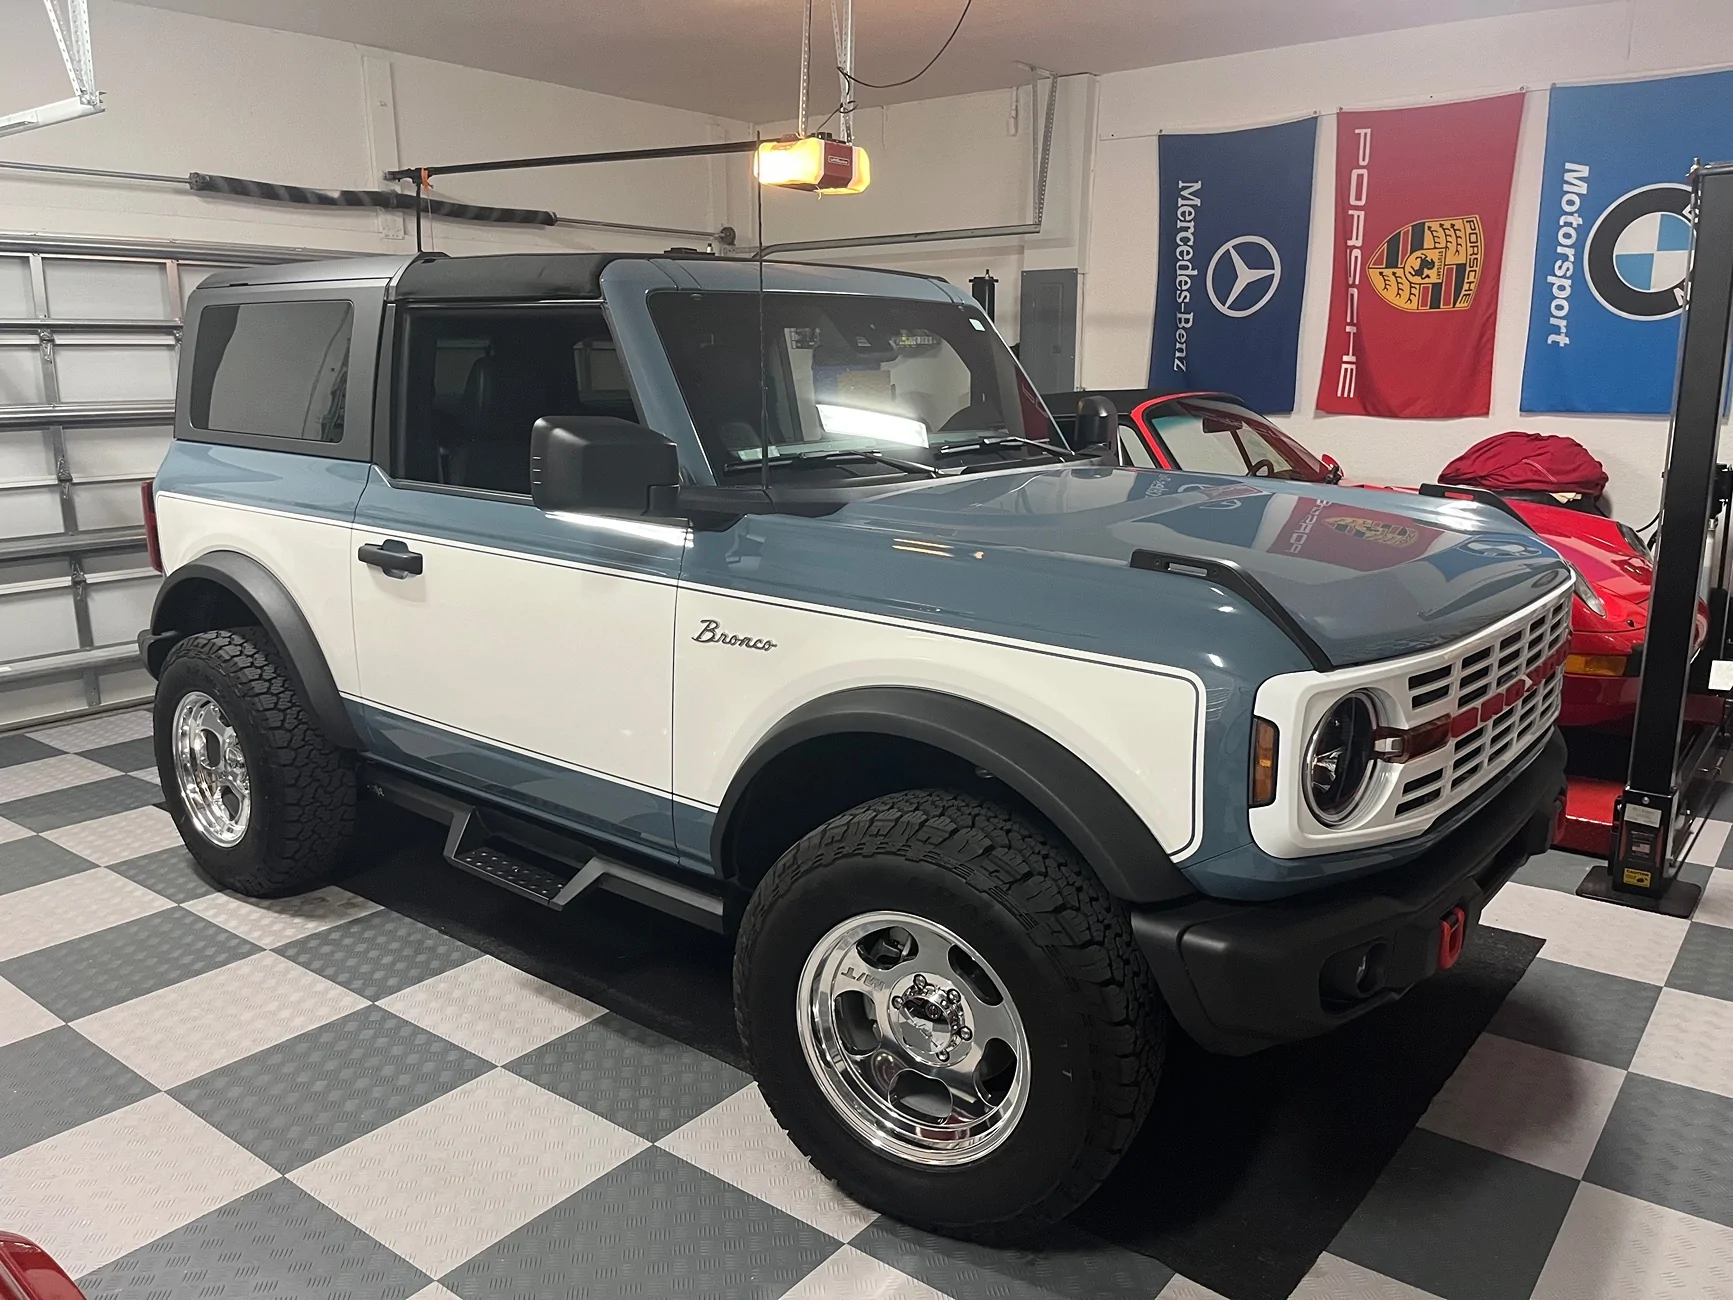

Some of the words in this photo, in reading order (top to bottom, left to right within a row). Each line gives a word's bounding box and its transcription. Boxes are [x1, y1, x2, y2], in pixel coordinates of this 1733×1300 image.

[1174, 180, 1201, 372] Mercedes-Benz
[1337, 128, 1371, 398] PORSCHE
[1459, 219, 1479, 305] PORSCHE
[1547, 162, 1589, 347] Motorsport
[690, 619, 778, 652] Bronco
[840, 966, 886, 992] M/T
